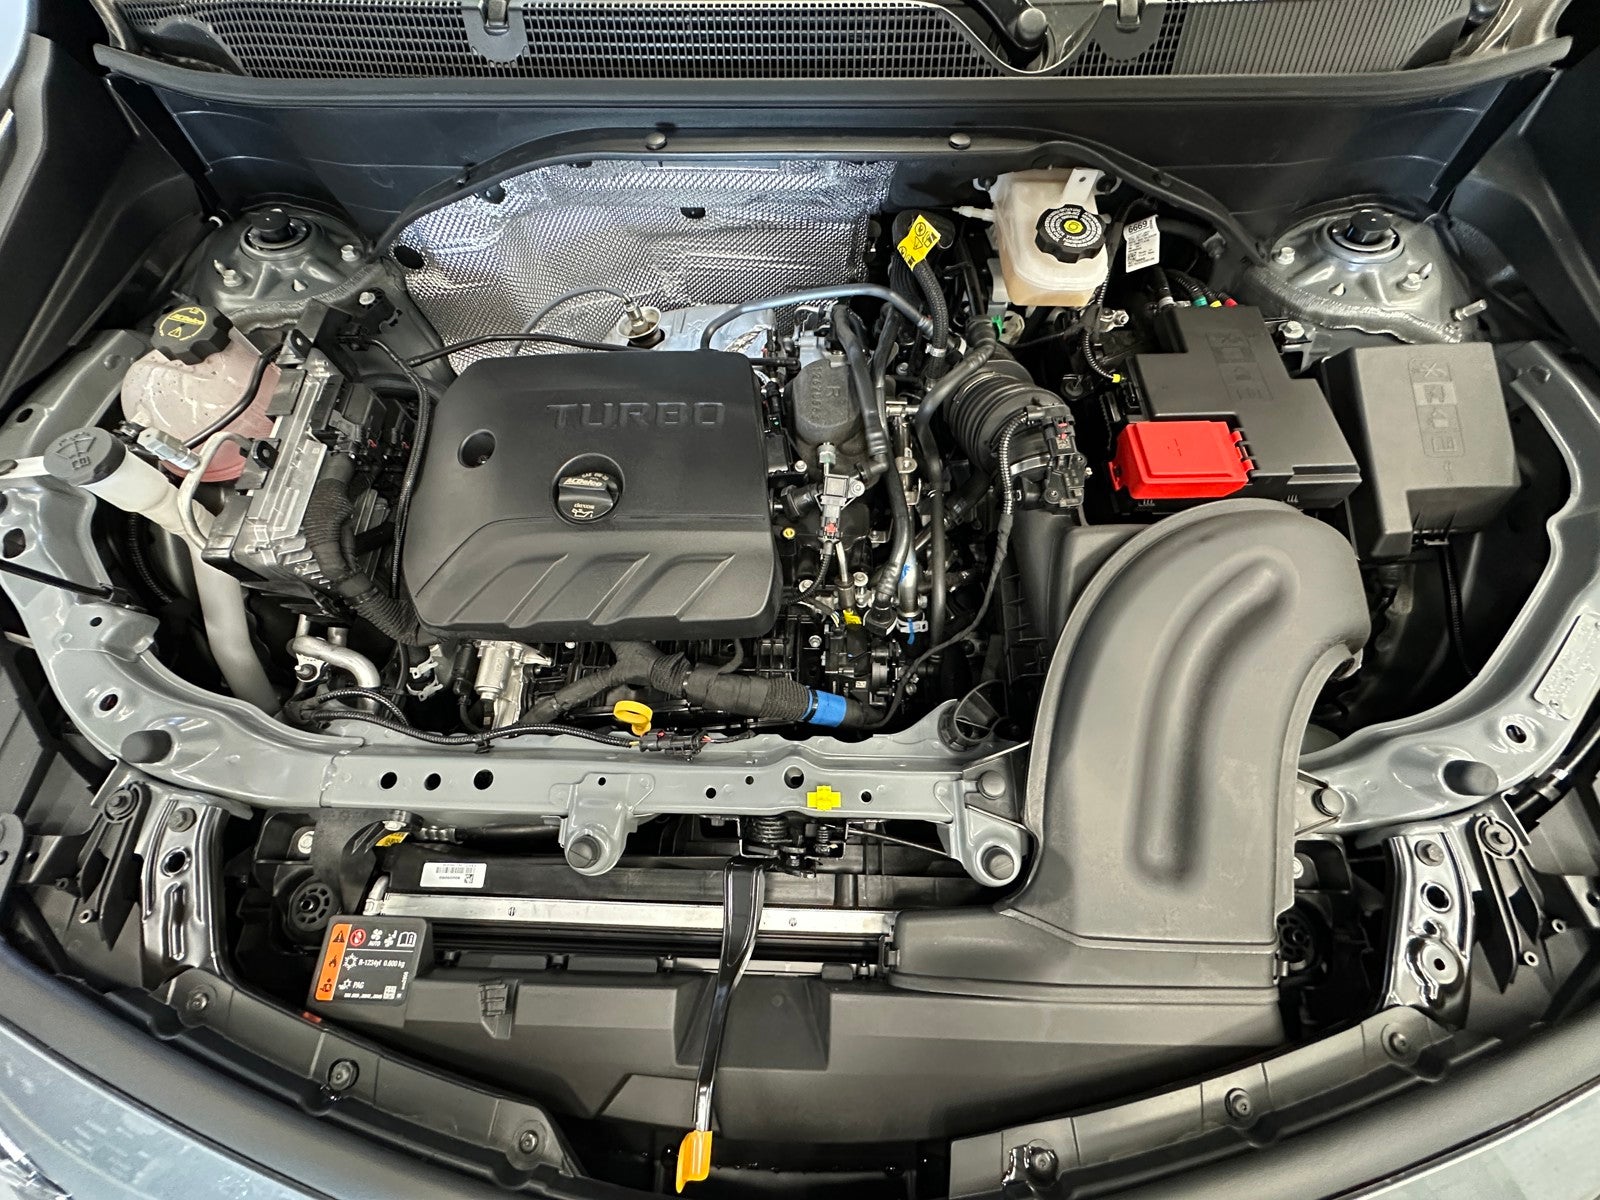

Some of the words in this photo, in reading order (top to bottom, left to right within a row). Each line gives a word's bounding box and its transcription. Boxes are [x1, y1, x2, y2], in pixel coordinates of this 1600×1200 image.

[1128, 220, 1148, 233] 6669
[546, 402, 726, 429] TURBO
[563, 477, 603, 487] ACDelco
[358, 958, 382, 968] R-1234yf
[398, 961, 406, 969] kg
[352, 981, 365, 989] PAG
